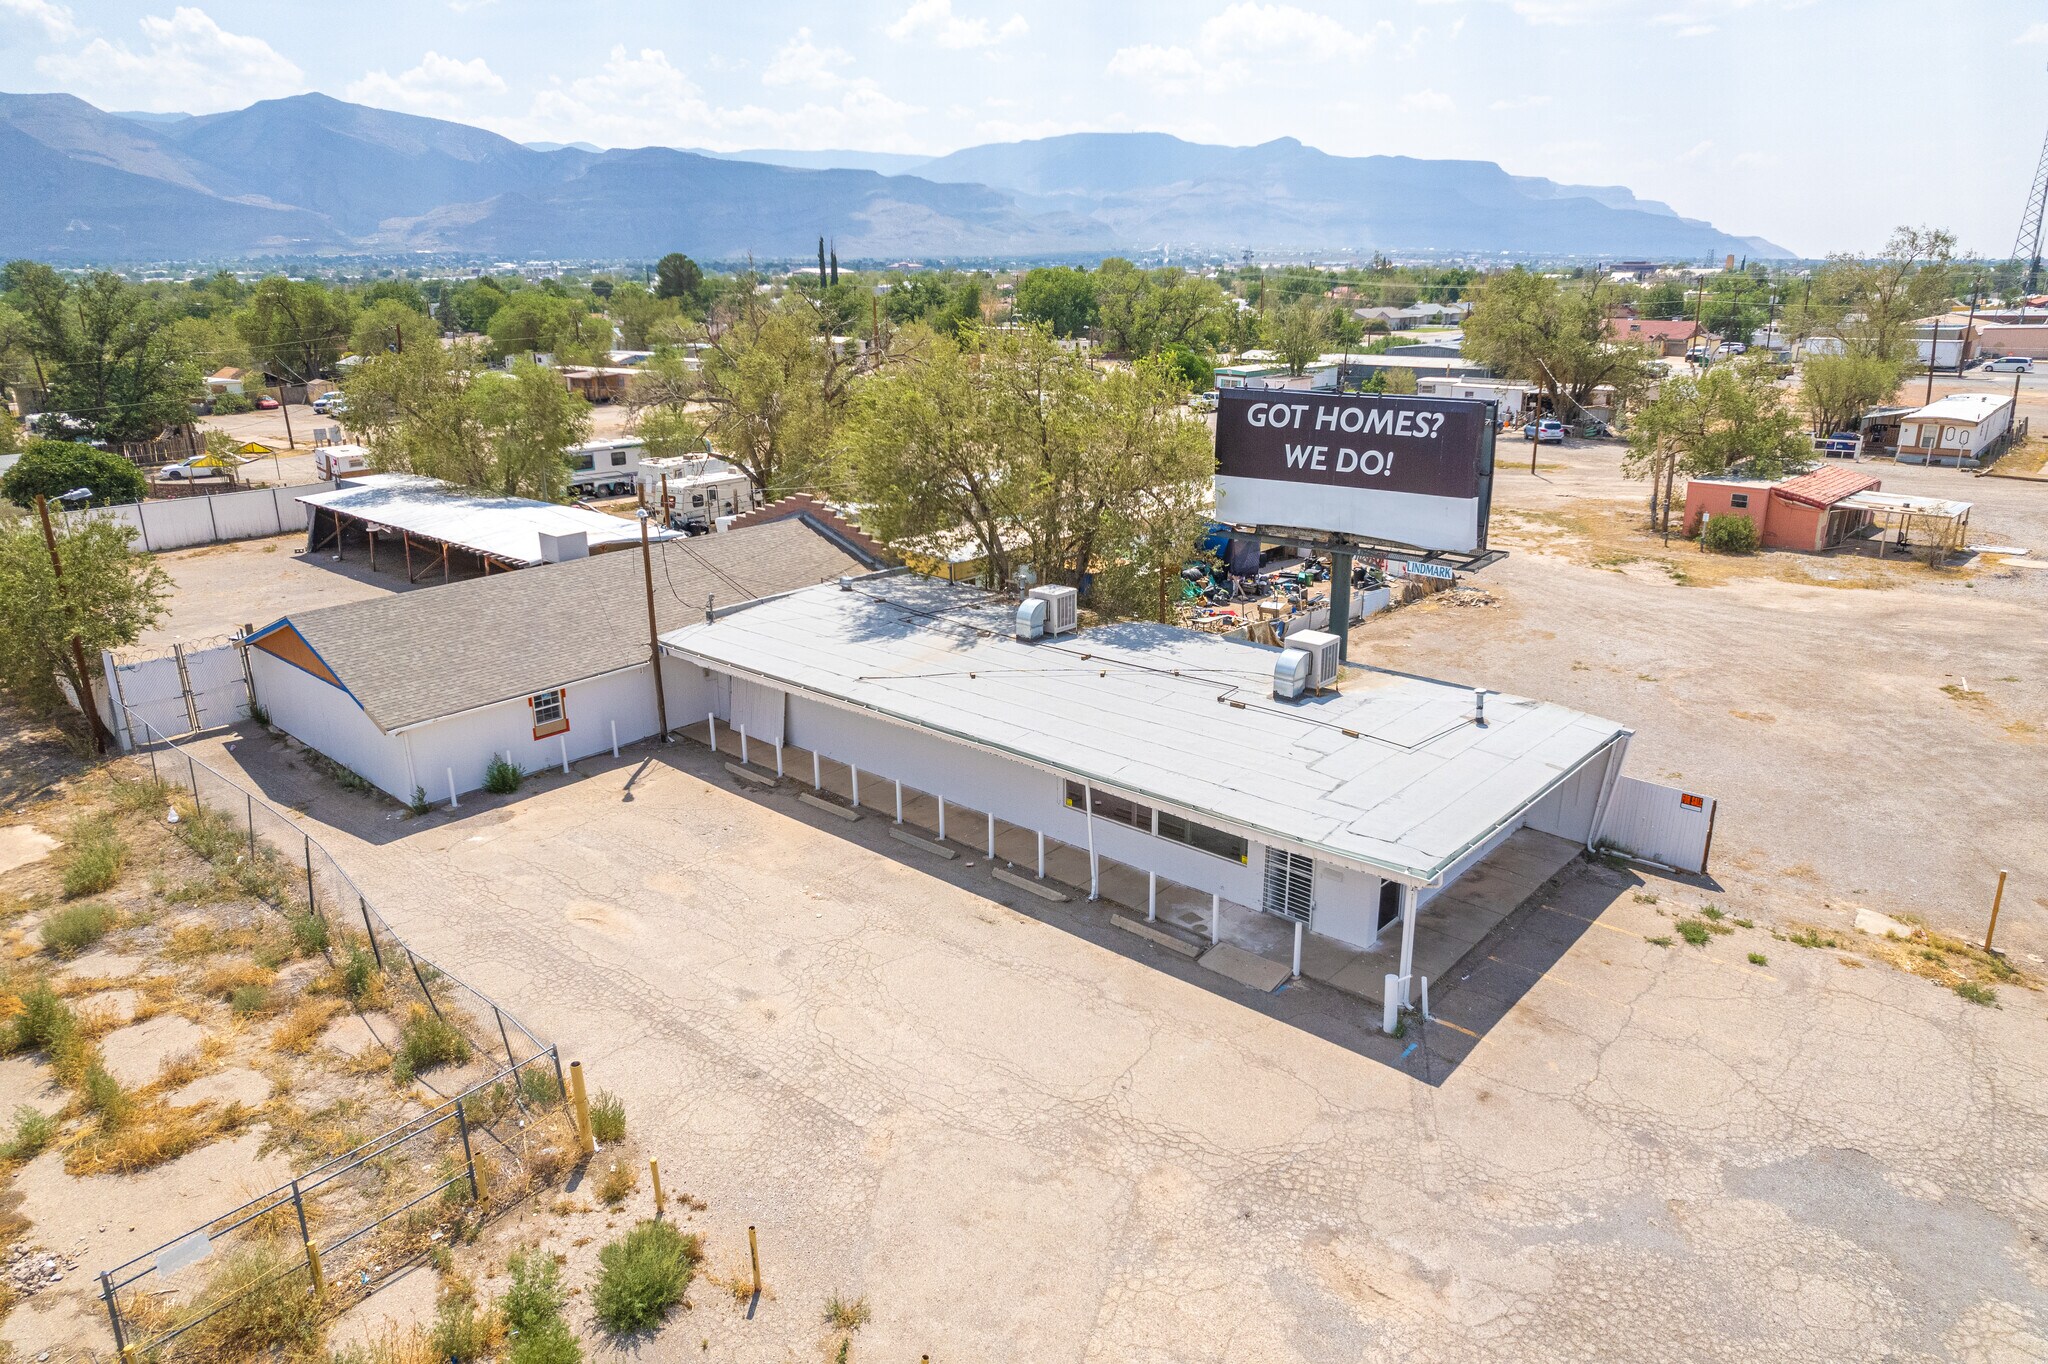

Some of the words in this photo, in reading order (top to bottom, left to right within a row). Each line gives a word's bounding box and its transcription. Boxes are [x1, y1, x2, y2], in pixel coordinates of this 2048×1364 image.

[1247, 403, 1309, 429] GOT
[1315, 406, 1445, 439] HOMES?
[1285, 443, 1328, 471] WE
[1336, 448, 1394, 477] DO!
[1407, 562, 1451, 578] LINDMARK
